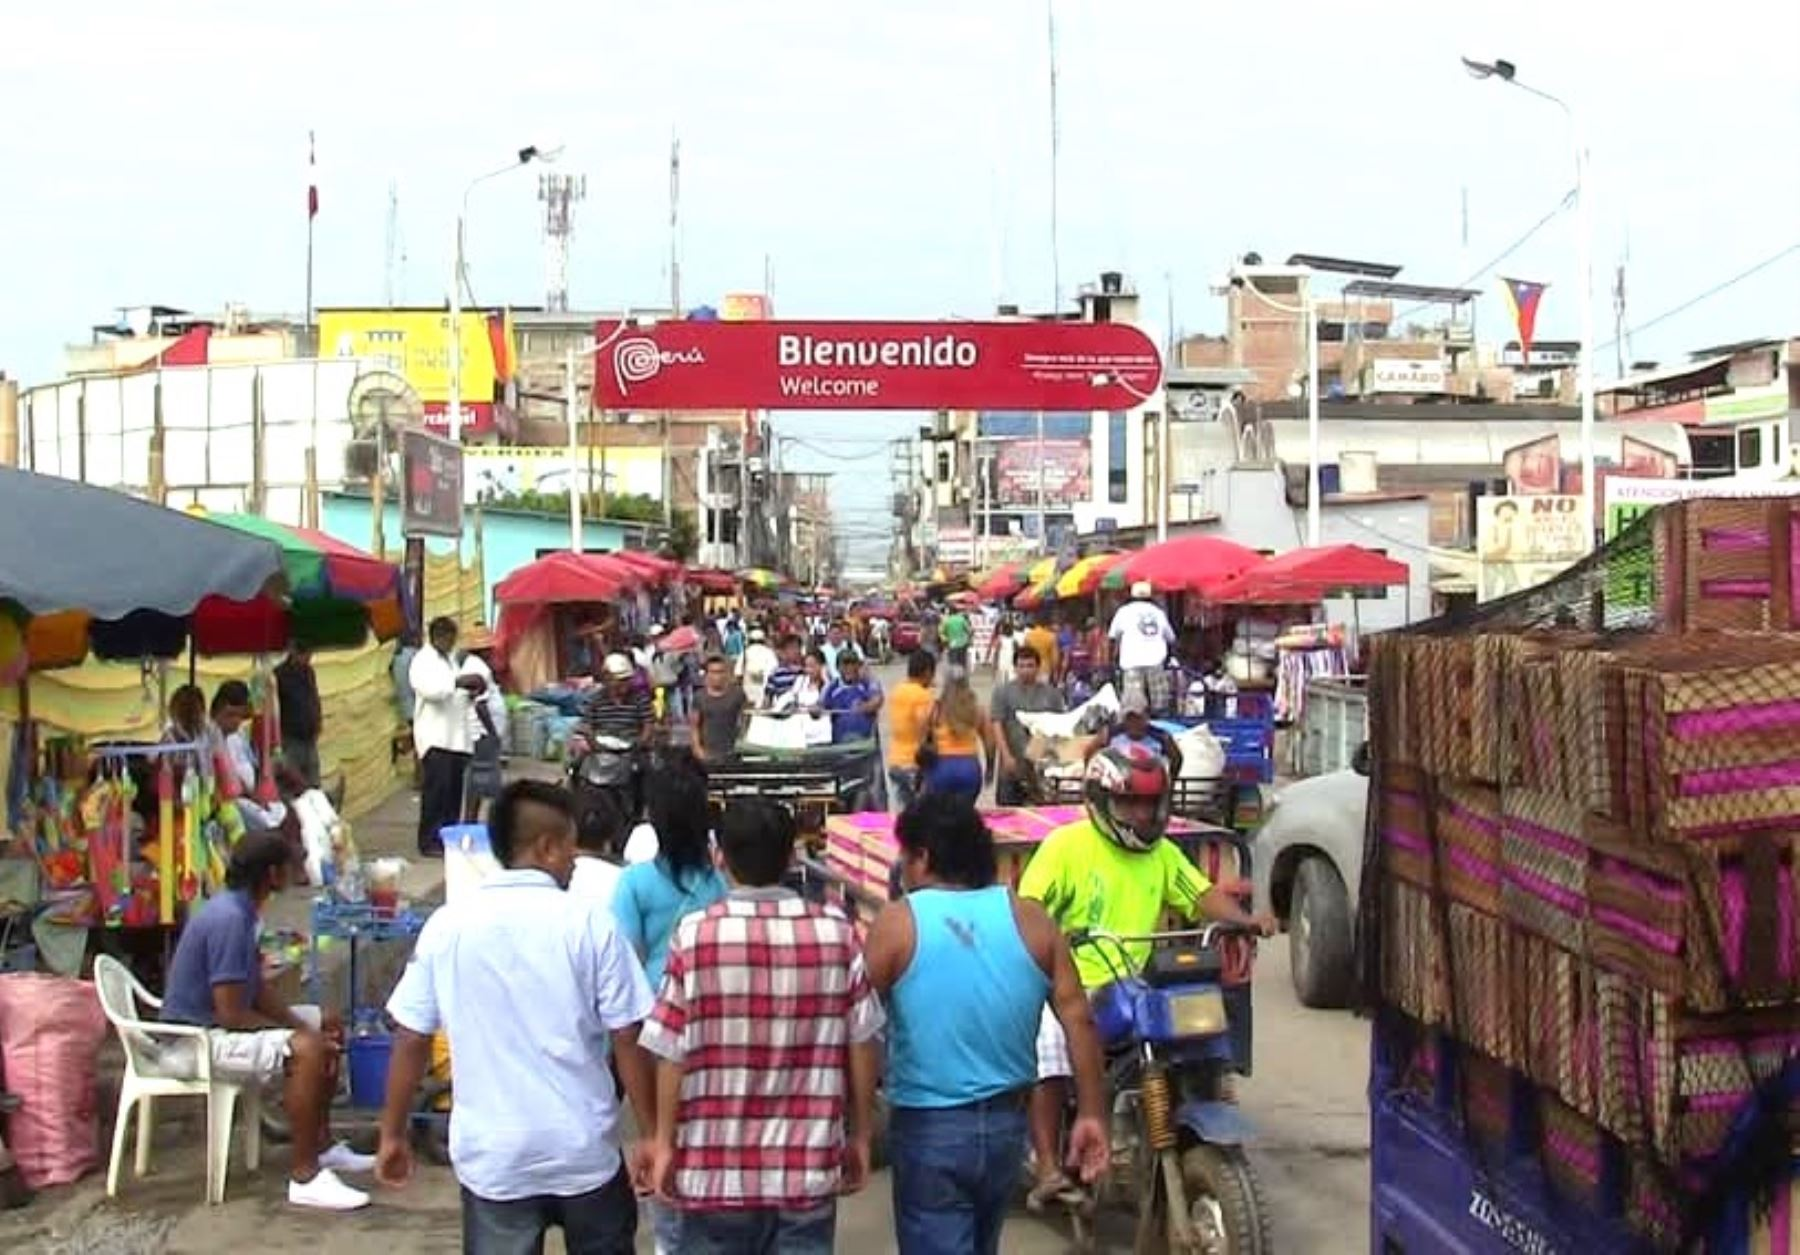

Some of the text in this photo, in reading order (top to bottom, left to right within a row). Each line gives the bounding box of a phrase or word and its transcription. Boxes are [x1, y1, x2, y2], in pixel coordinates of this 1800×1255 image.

[778, 334, 978, 367] Bienvenido
[780, 375, 880, 397] Welcome
[1530, 498, 1577, 514] NO
